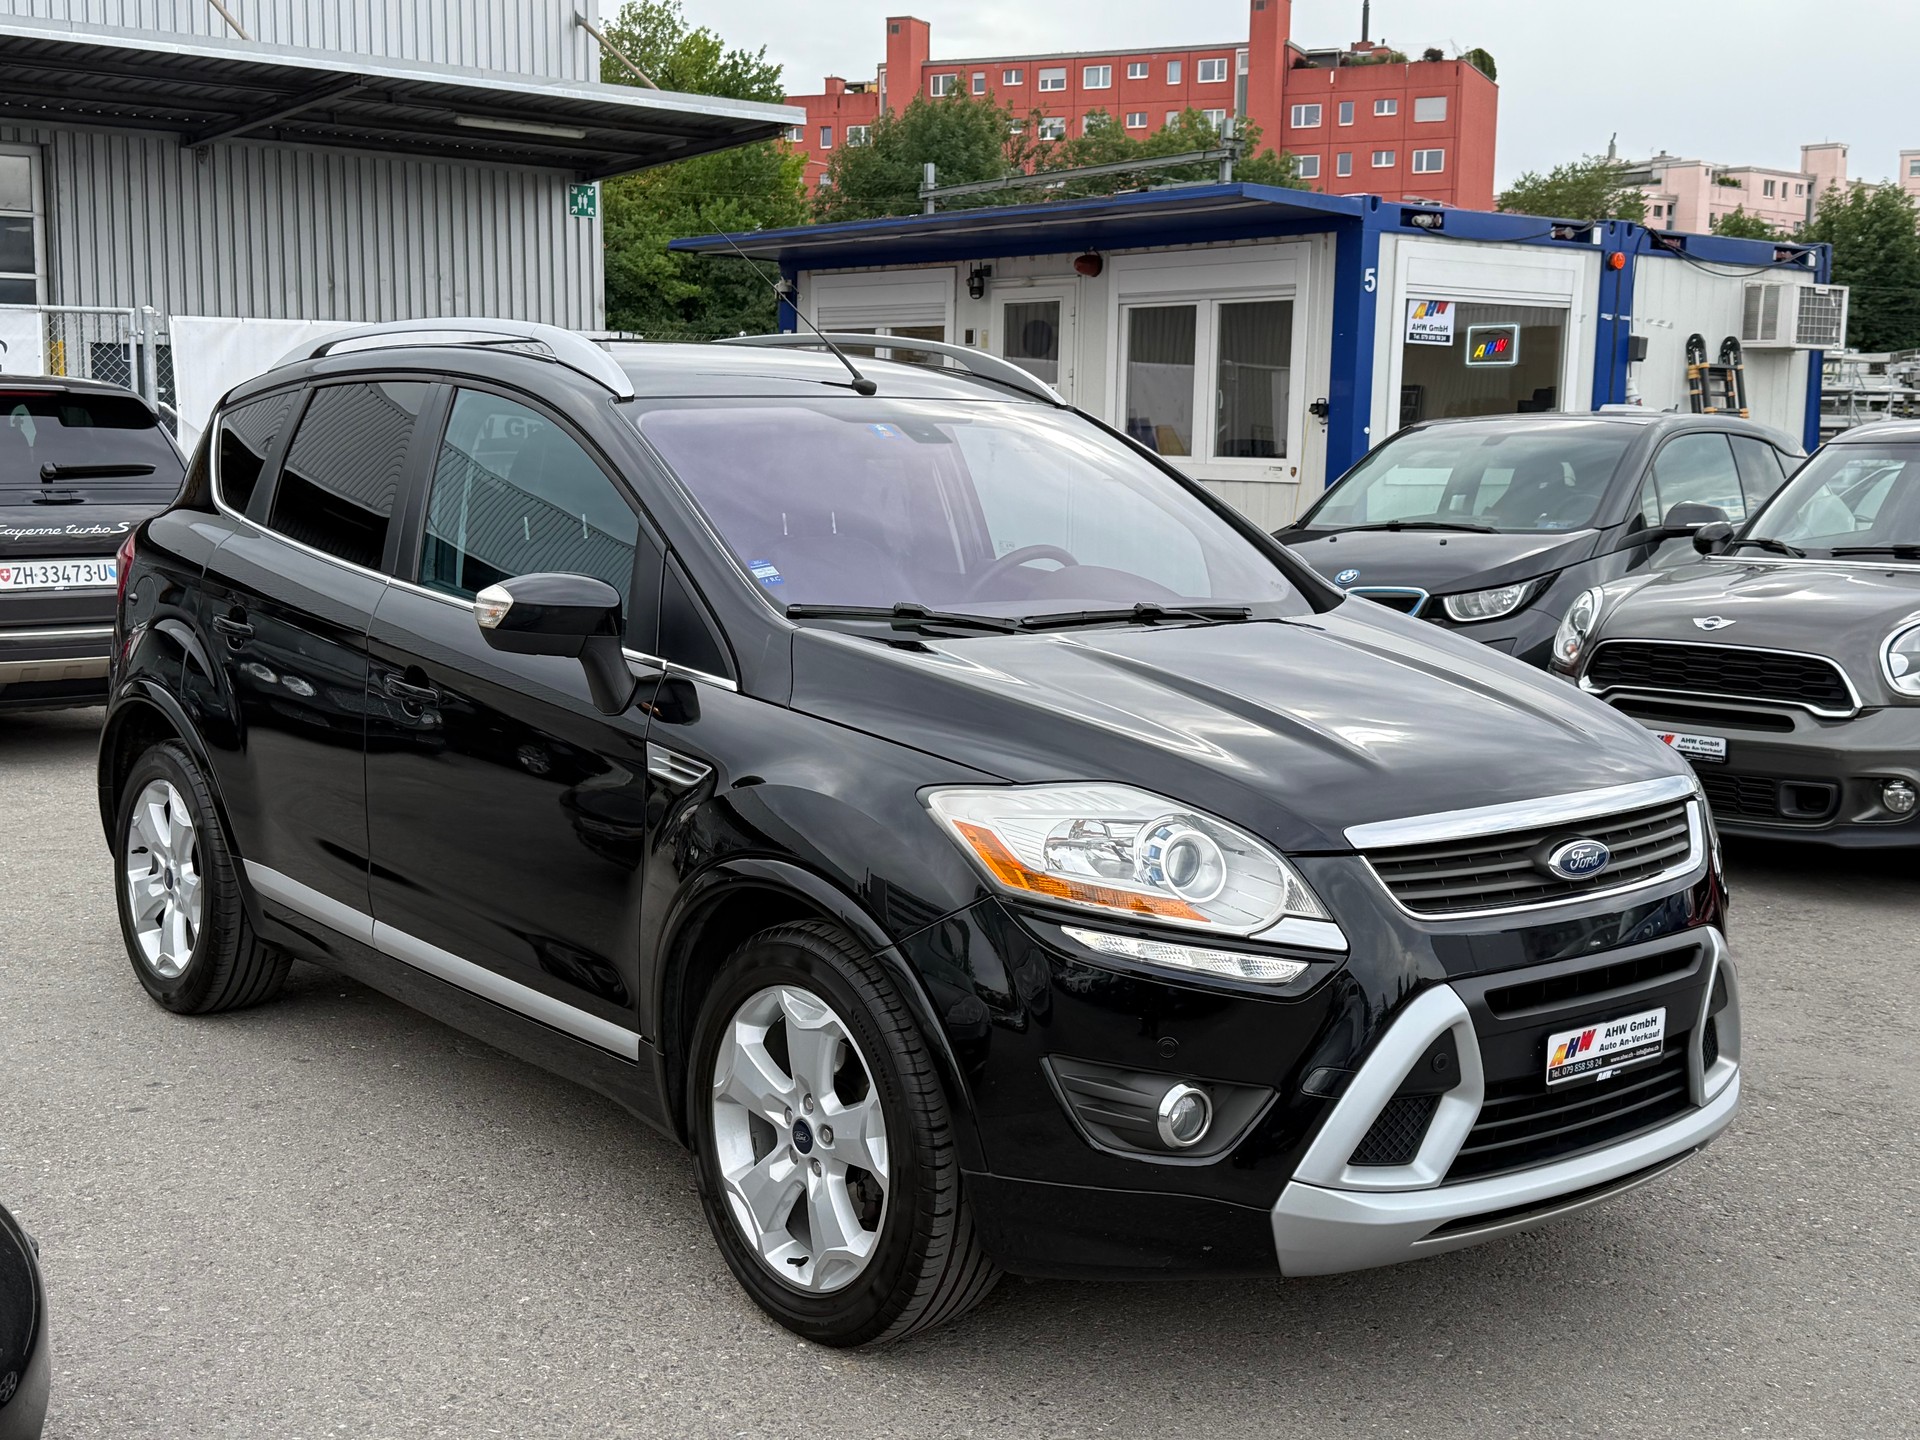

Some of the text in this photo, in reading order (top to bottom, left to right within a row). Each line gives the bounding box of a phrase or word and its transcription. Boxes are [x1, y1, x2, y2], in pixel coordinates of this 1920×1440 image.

[1364, 268, 1376, 292] 5
[1412, 301, 1450, 320] AHW
[1411, 323, 1448, 333] AHW GmbH
[1473, 339, 1509, 358] AHW
[110, 522, 130, 534] S
[1570, 848, 1600, 870] Ford
[1604, 1015, 1658, 1039] AHW GmbH
[1549, 1028, 1597, 1068] AHW
[1599, 1028, 1661, 1053] Auto An-Verkauf
[1551, 1068, 1561, 1079] Tel.
[1594, 1057, 1603, 1067] 24
